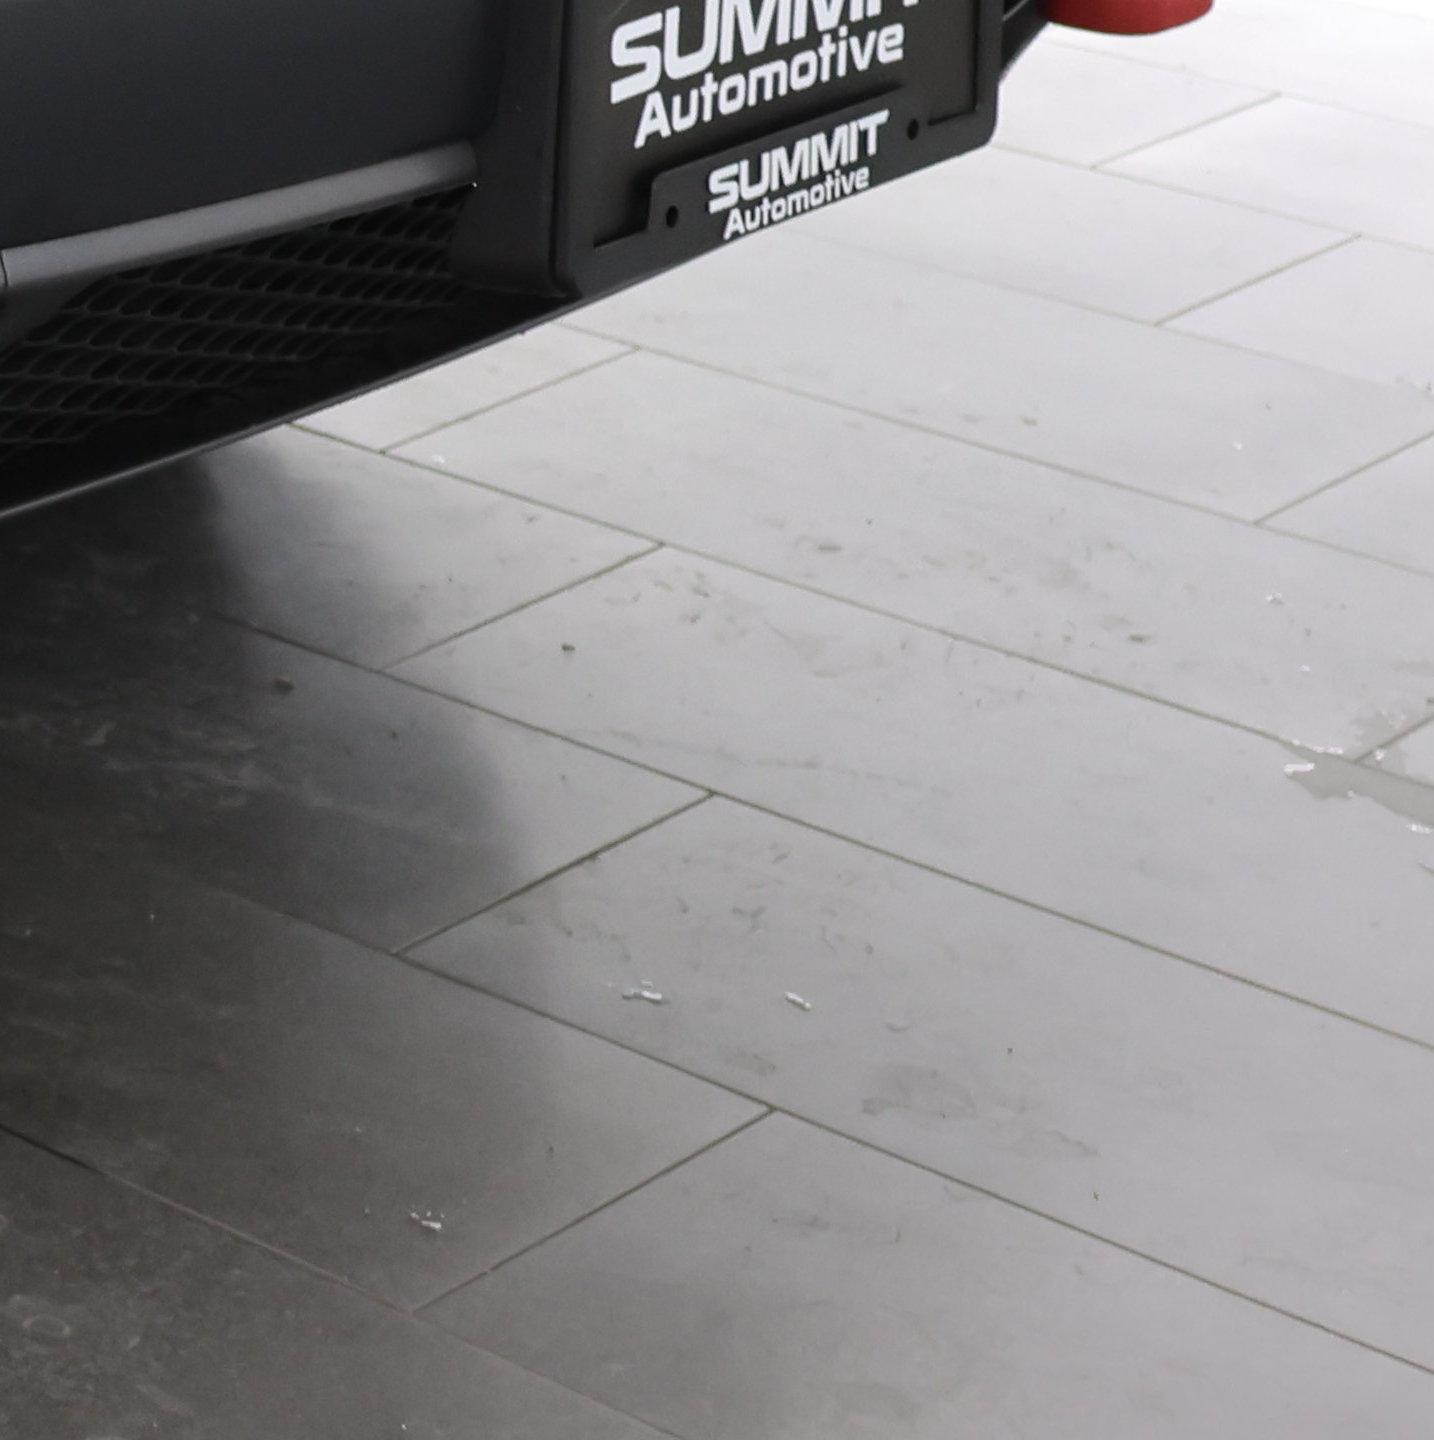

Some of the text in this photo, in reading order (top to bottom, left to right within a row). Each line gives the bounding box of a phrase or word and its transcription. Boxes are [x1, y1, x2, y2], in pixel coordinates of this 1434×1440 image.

[633, 22, 905, 150] Automotive
[707, 108, 891, 215] SUMMIT
[722, 165, 871, 241] Automotive
